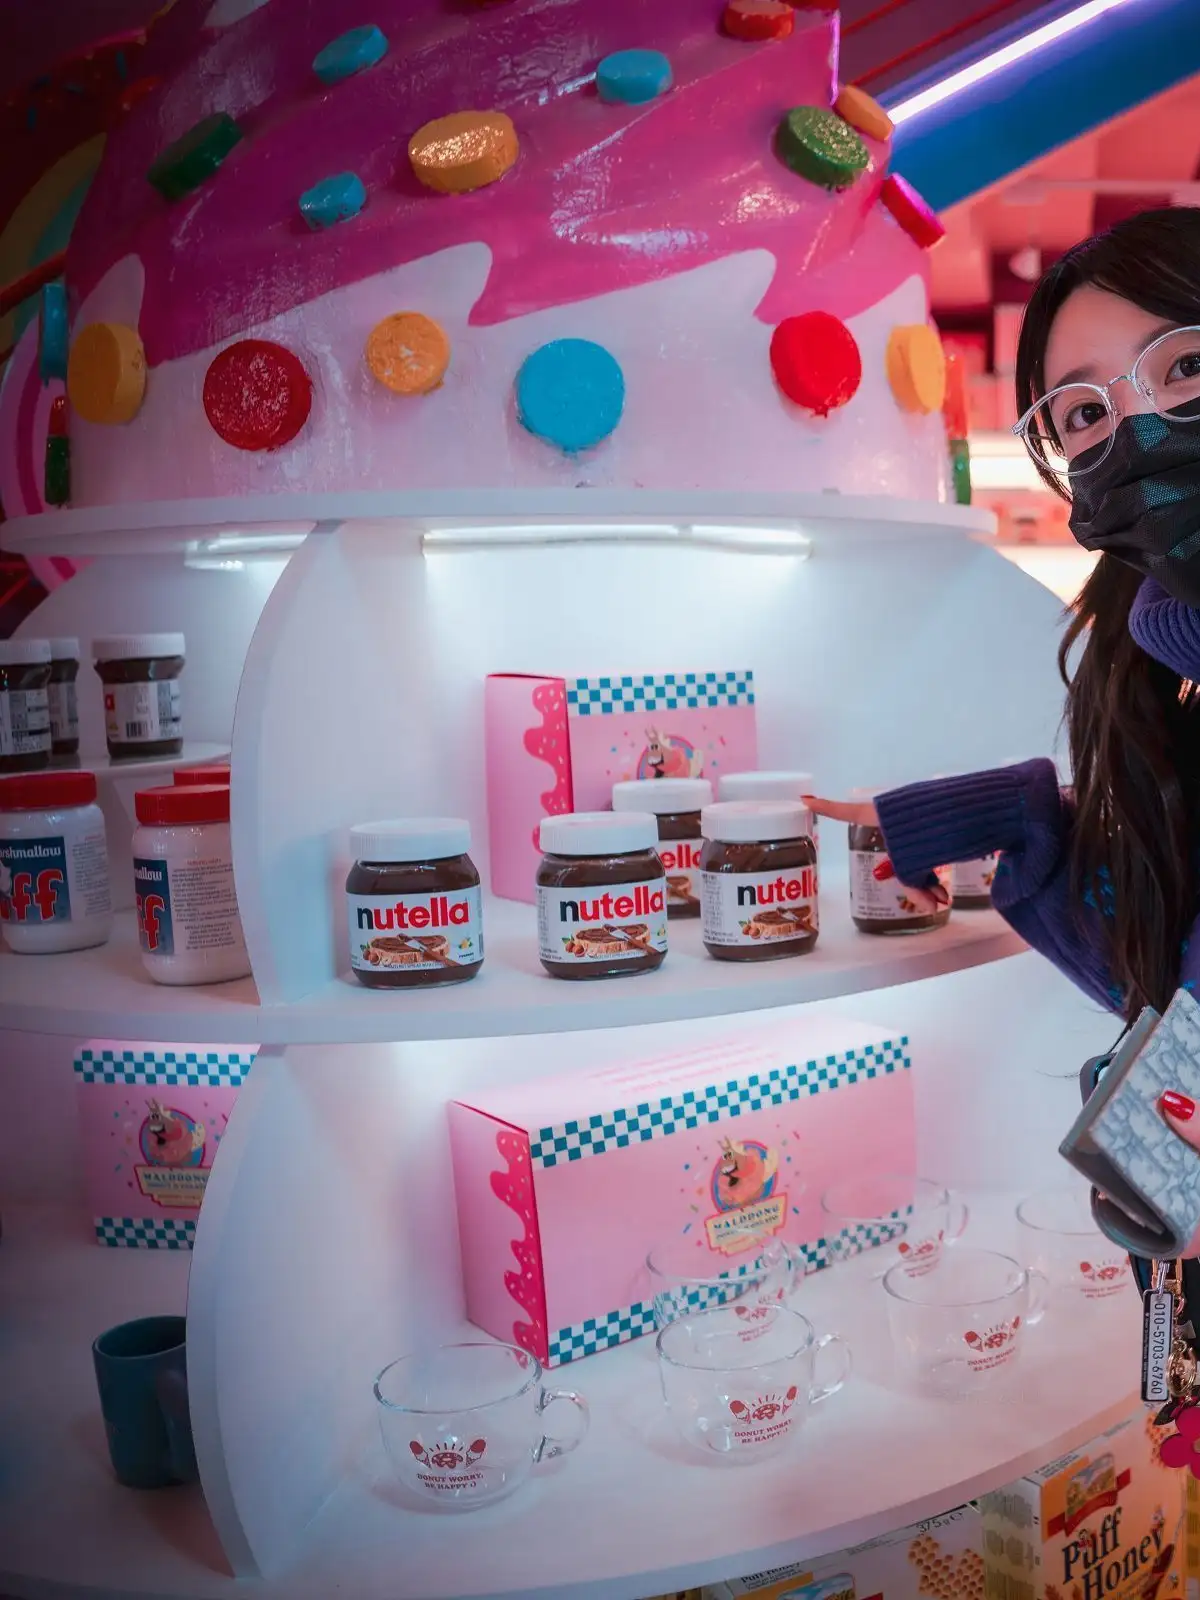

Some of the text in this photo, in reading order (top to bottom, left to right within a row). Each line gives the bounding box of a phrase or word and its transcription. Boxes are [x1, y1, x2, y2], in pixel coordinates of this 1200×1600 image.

[357, 896, 469, 930] nutella
[559, 885, 664, 922] nutella
[1150, 1303, 1166, 1395] 010-5703-6760
[734, 1428, 765, 1437] DONUT
[416, 1473, 446, 1483] DONUT
[1061, 1506, 1123, 1585] Puff
[1082, 1526, 1165, 1600] Honey
